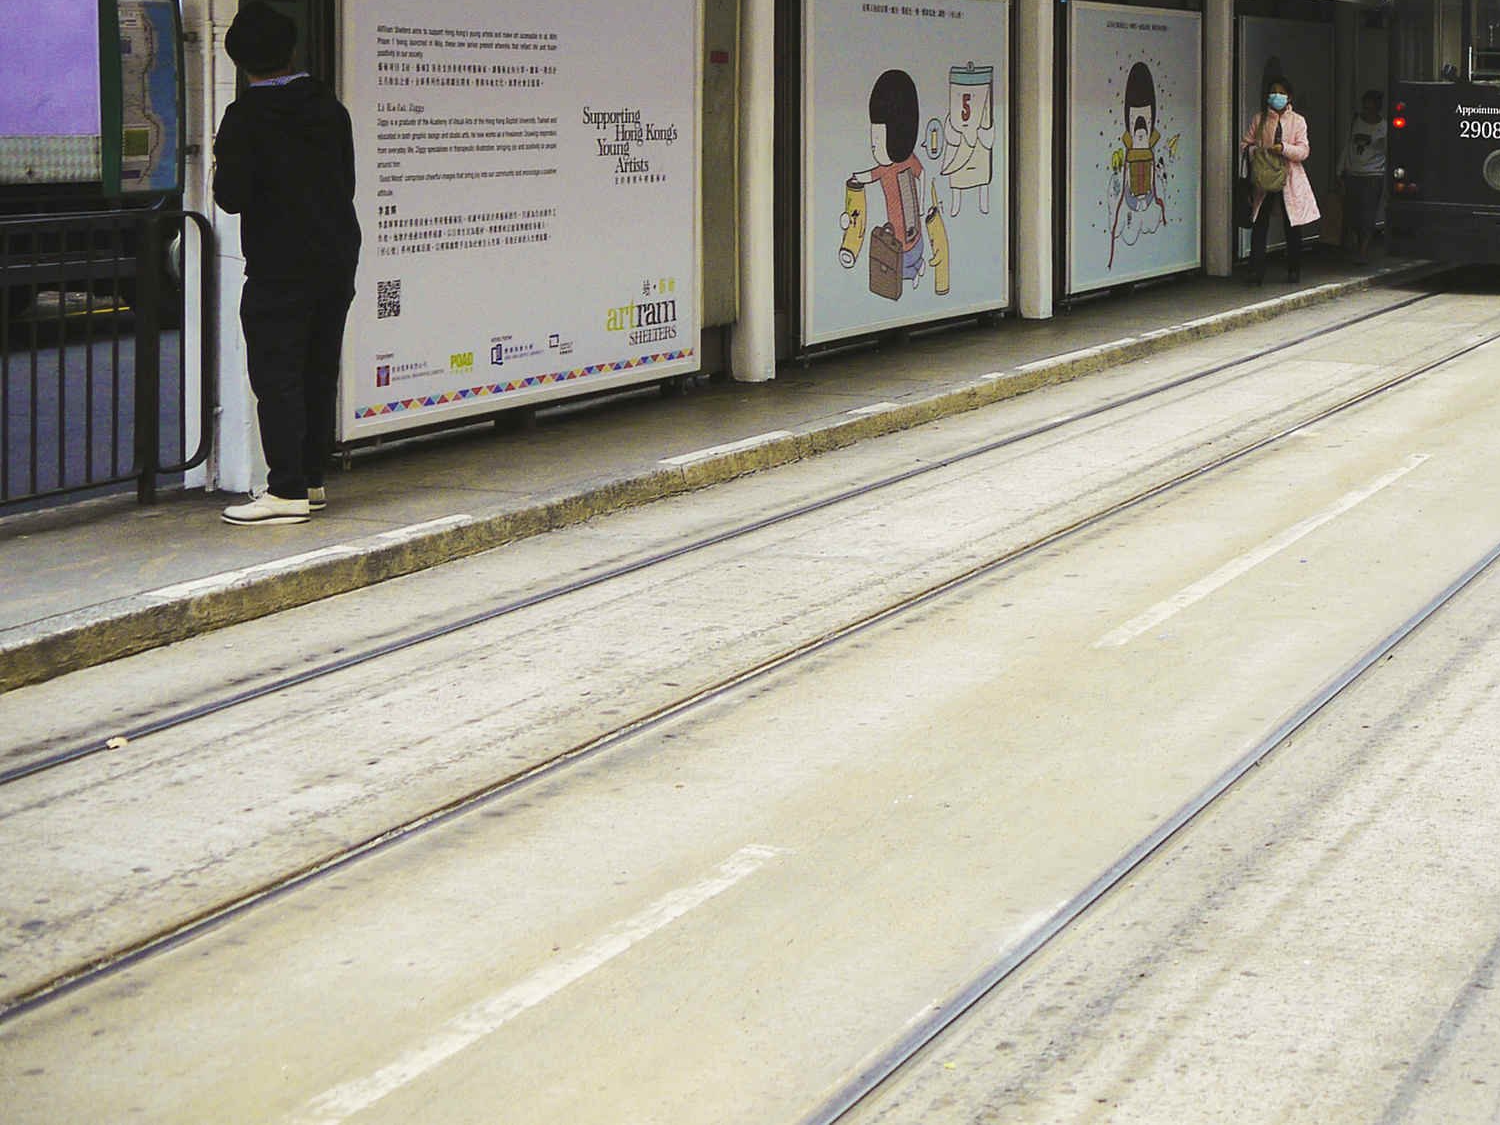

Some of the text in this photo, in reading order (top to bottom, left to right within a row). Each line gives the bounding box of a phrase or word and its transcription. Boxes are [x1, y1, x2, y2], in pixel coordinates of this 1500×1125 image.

[581, 106, 641, 130] Supporting
[960, 93, 972, 122] 5
[614, 123, 678, 147] Hong Kong's
[596, 138, 631, 161] Young
[614, 156, 650, 174] Artists
[628, 324, 678, 347] SHELTERS
